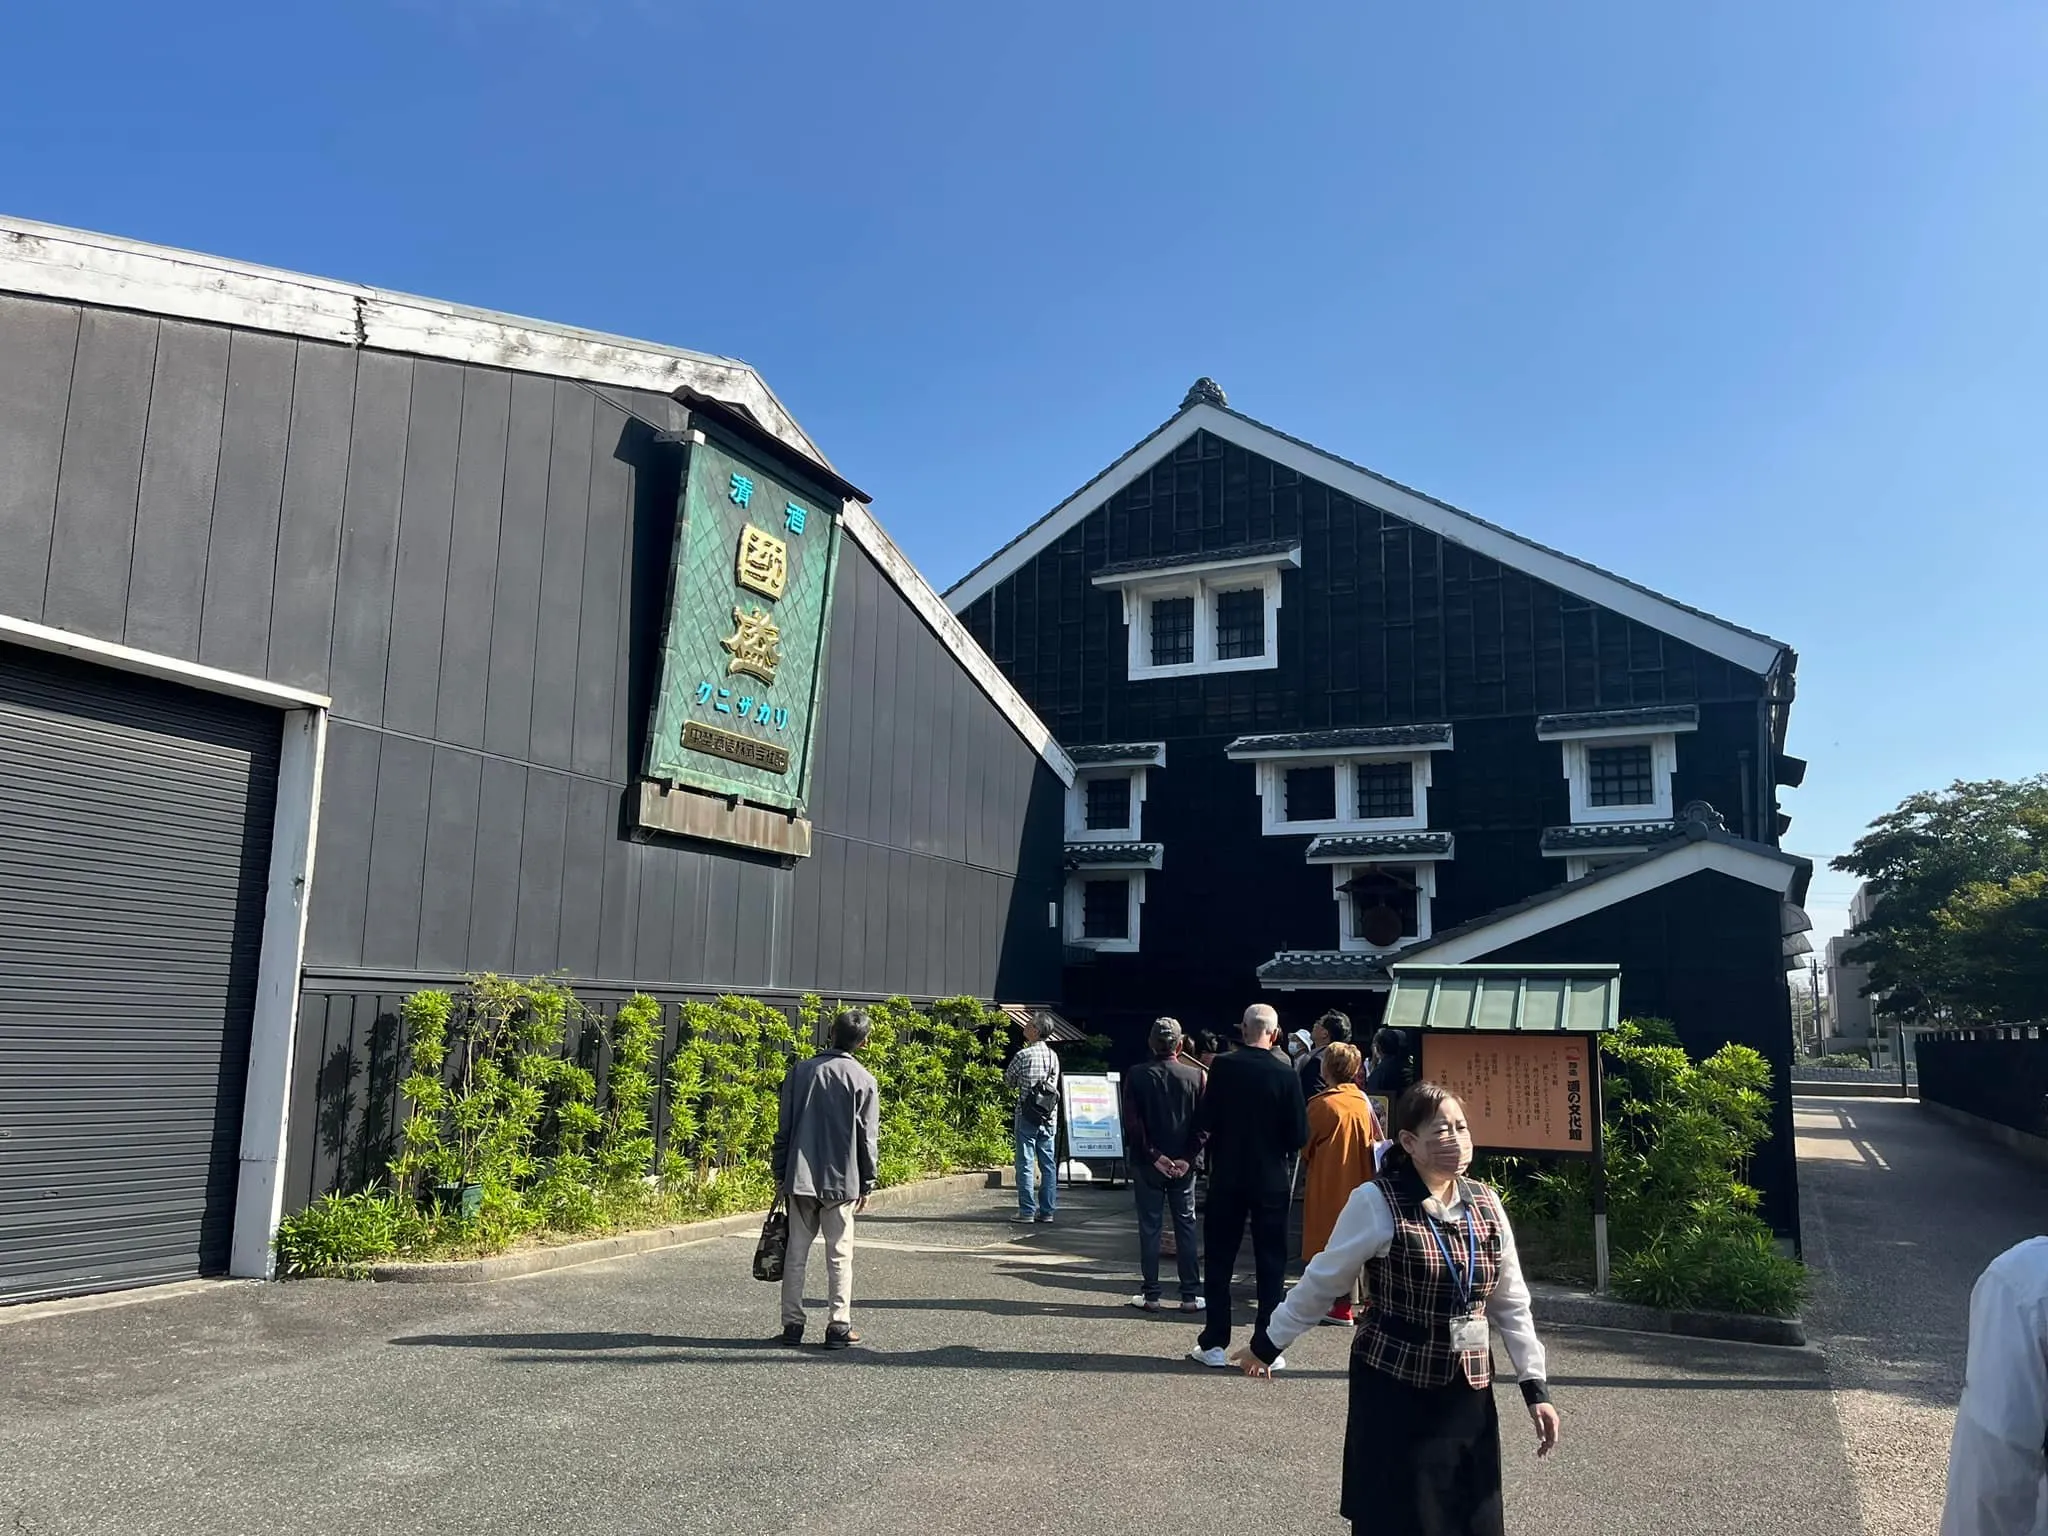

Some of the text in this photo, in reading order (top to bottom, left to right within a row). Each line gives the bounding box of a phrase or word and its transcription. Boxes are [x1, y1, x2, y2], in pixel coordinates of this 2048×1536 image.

[695, 681, 788, 731] クニザカリ
